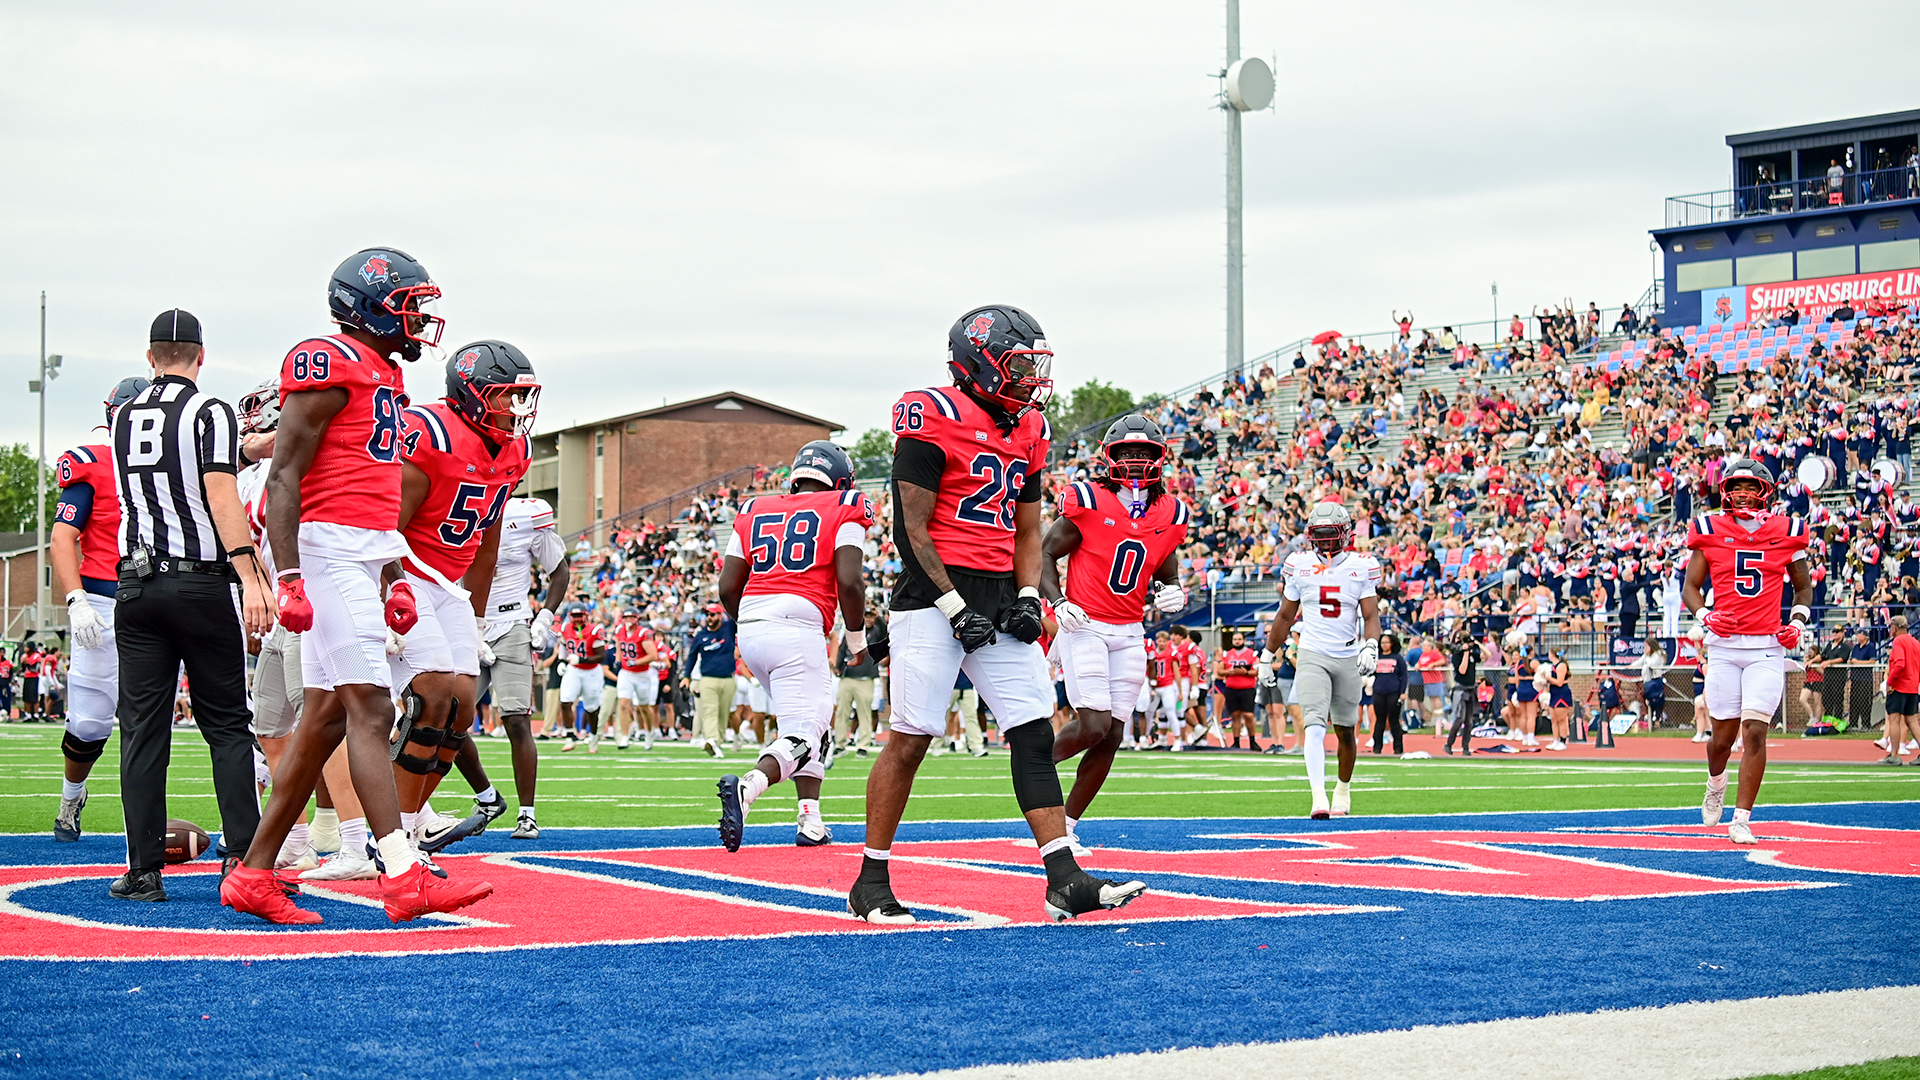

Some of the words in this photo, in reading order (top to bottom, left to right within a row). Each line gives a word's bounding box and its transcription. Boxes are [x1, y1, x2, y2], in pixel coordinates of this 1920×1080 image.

[1751, 277, 1892, 311] SHIPPENSBURG
[293, 350, 330, 381] 89
[895, 401, 923, 431] 26
[127, 407, 167, 467] B
[404, 430, 422, 457] 4
[955, 452, 1030, 532] 26
[55, 503, 77, 522] 76
[437, 482, 511, 548] 54
[751, 509, 822, 574] 58
[160, 560, 169, 572] S
[1107, 538, 1147, 595] 0
[1734, 550, 1765, 598] 5
[1319, 586, 1341, 618] 5
[566, 638, 587, 660] 94
